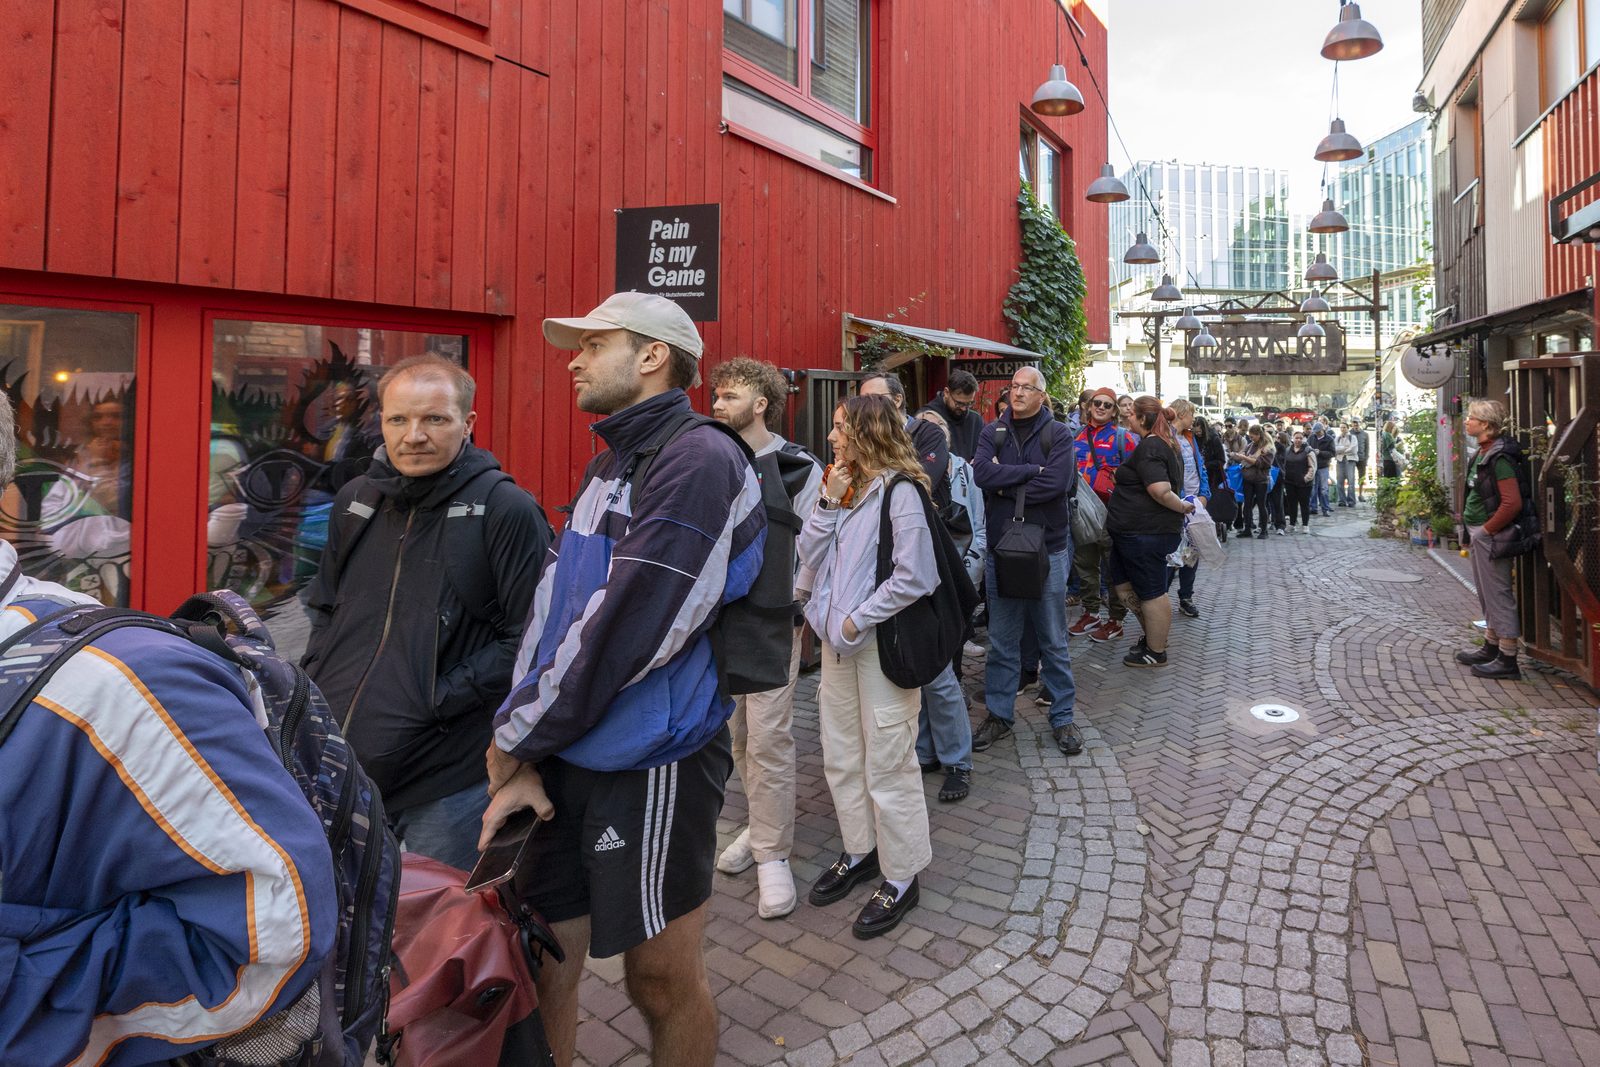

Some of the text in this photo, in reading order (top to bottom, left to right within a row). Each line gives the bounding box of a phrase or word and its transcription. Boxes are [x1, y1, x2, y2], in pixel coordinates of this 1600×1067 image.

[648, 217, 690, 240] Pain
[648, 242, 697, 267] is my
[647, 266, 706, 287] Game
[594, 839, 626, 852] adidas
